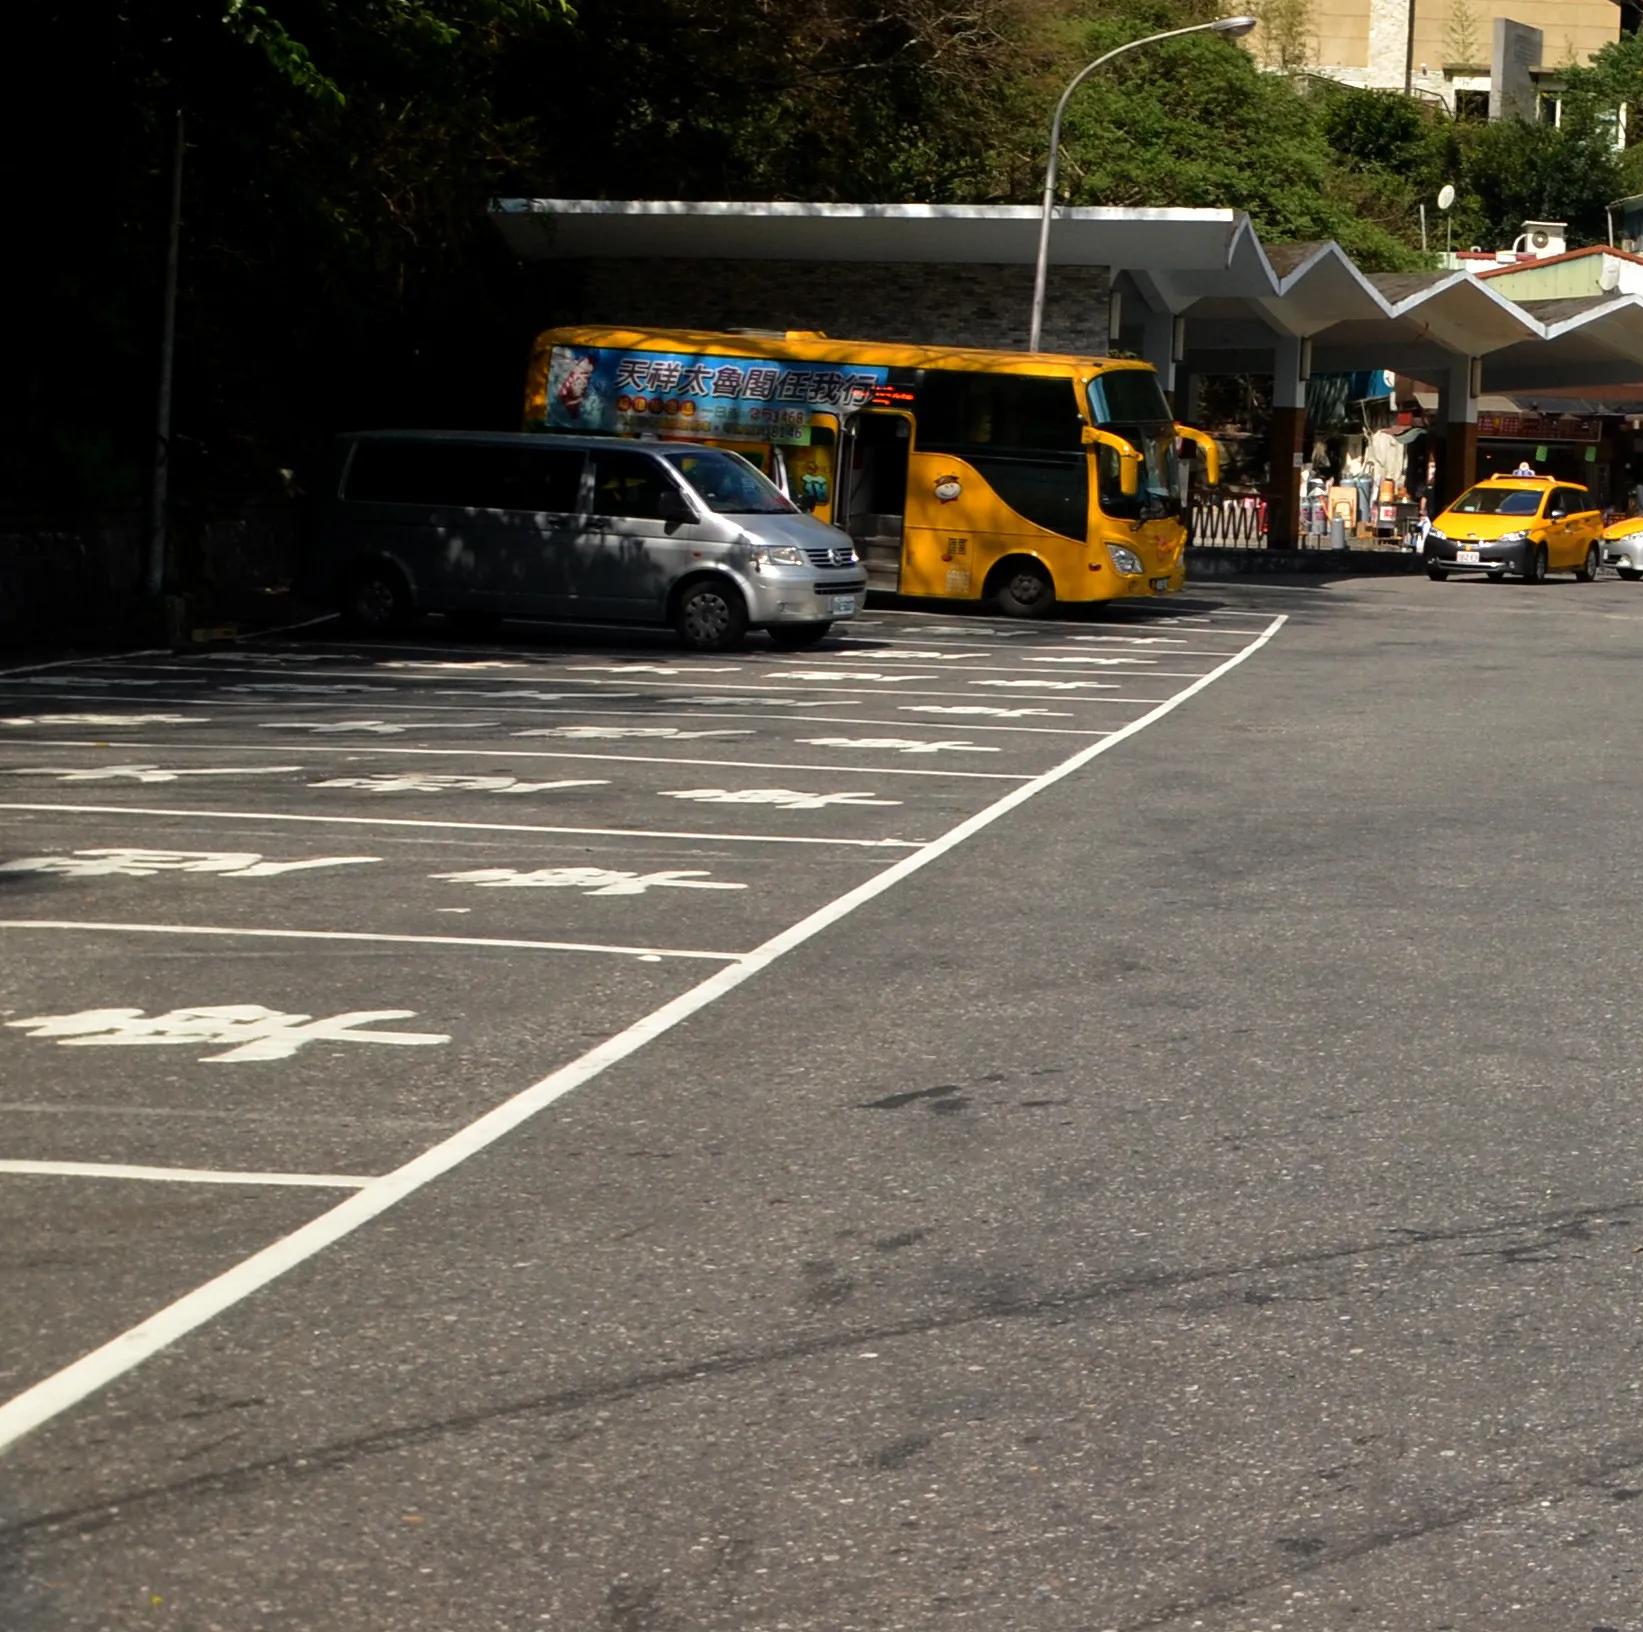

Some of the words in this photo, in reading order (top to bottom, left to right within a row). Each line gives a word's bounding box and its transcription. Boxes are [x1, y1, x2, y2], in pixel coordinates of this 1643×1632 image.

[613, 358, 878, 406] 天祥太魯閣任我行
